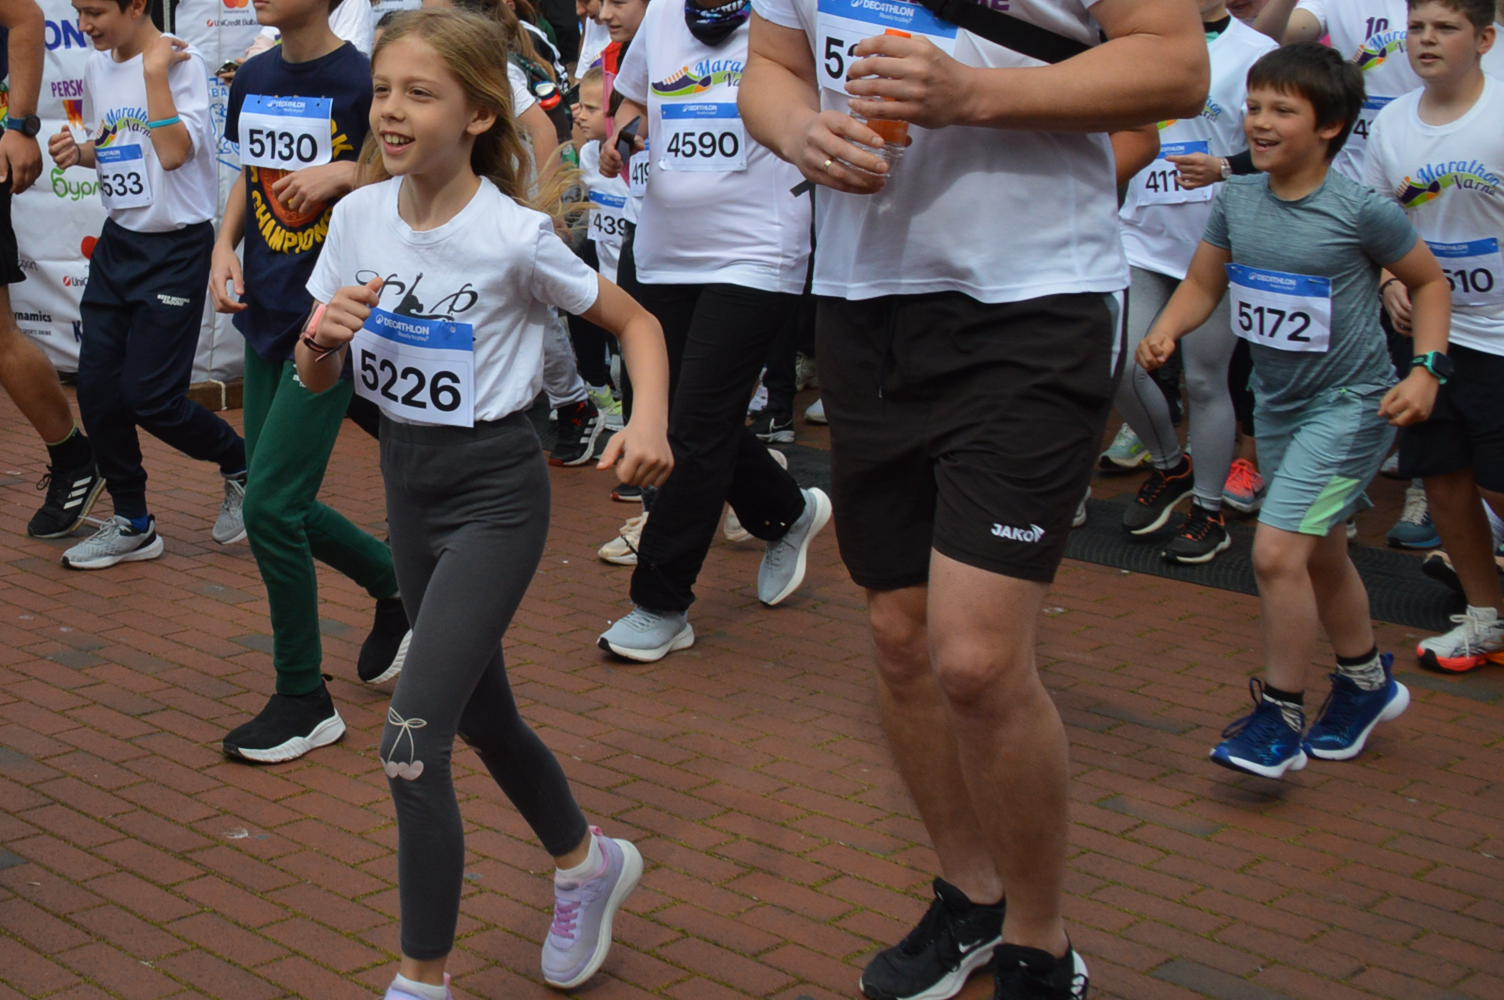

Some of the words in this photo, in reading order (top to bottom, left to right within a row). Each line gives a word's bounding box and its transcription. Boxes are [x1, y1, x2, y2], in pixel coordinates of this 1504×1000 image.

[862, 0, 915, 17] DECATHLON
[248, 128, 318, 163] 5130
[667, 131, 739, 159] 4590
[1417, 160, 1501, 187] Marathon
[1451, 174, 1496, 196] Varna
[251, 190, 332, 254] CHAMPION
[383, 317, 430, 336] DECATHLON
[1238, 300, 1311, 342] 5172
[360, 348, 462, 412] 5226
[990, 522, 1036, 543] JAKO
